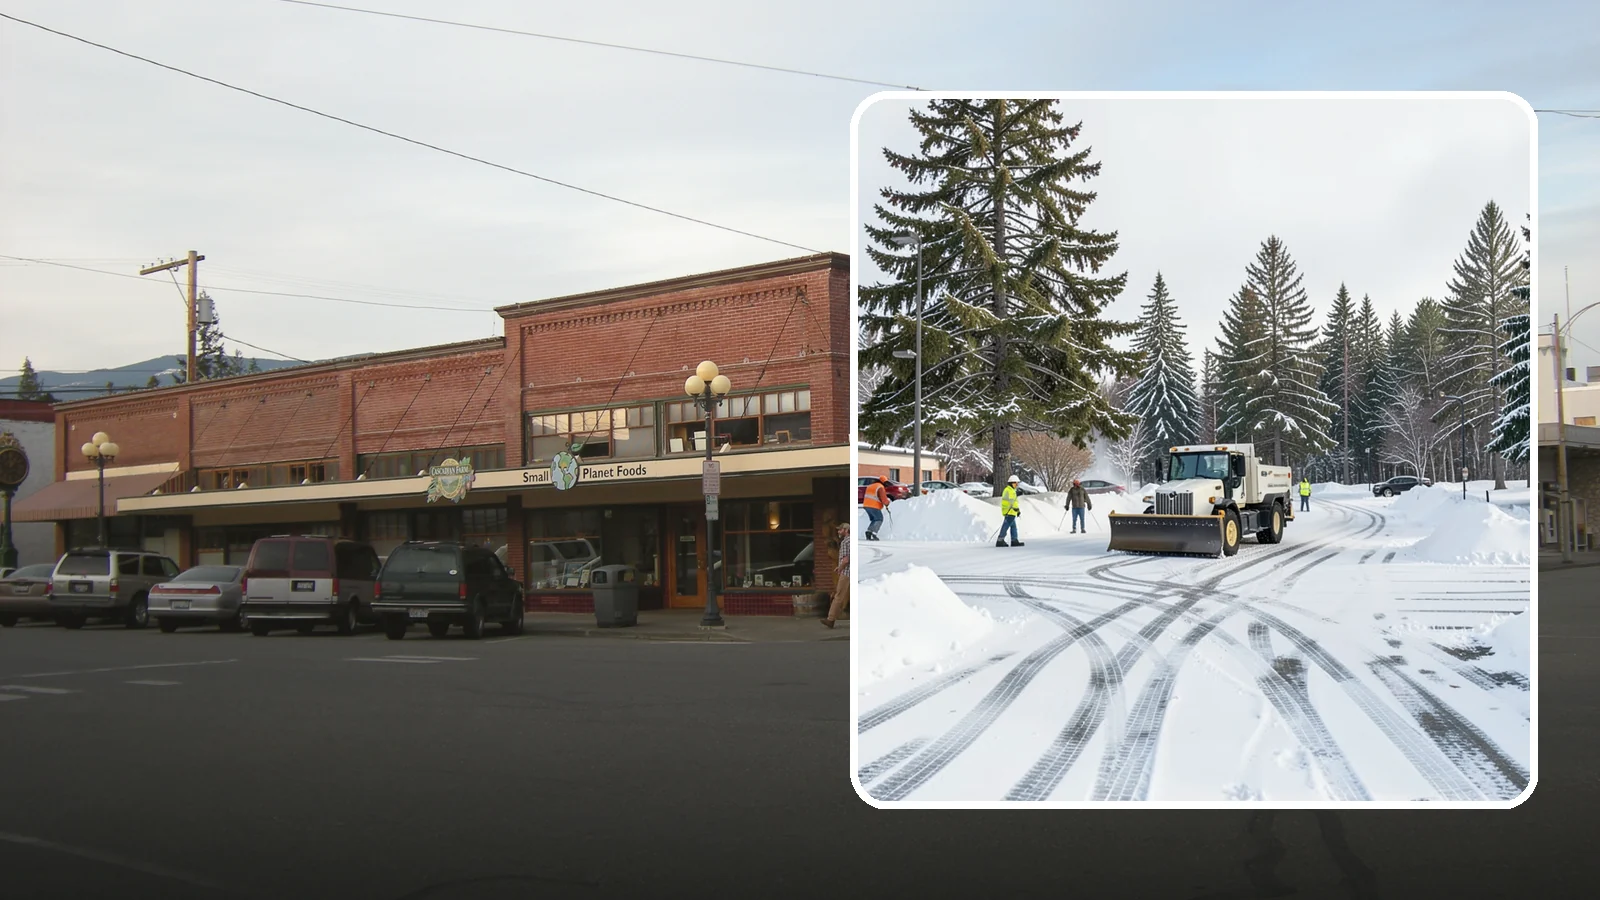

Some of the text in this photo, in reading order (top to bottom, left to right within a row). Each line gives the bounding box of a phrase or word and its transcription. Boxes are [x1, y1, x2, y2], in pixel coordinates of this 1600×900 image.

[523, 464, 647, 483] Small Planet Foods
